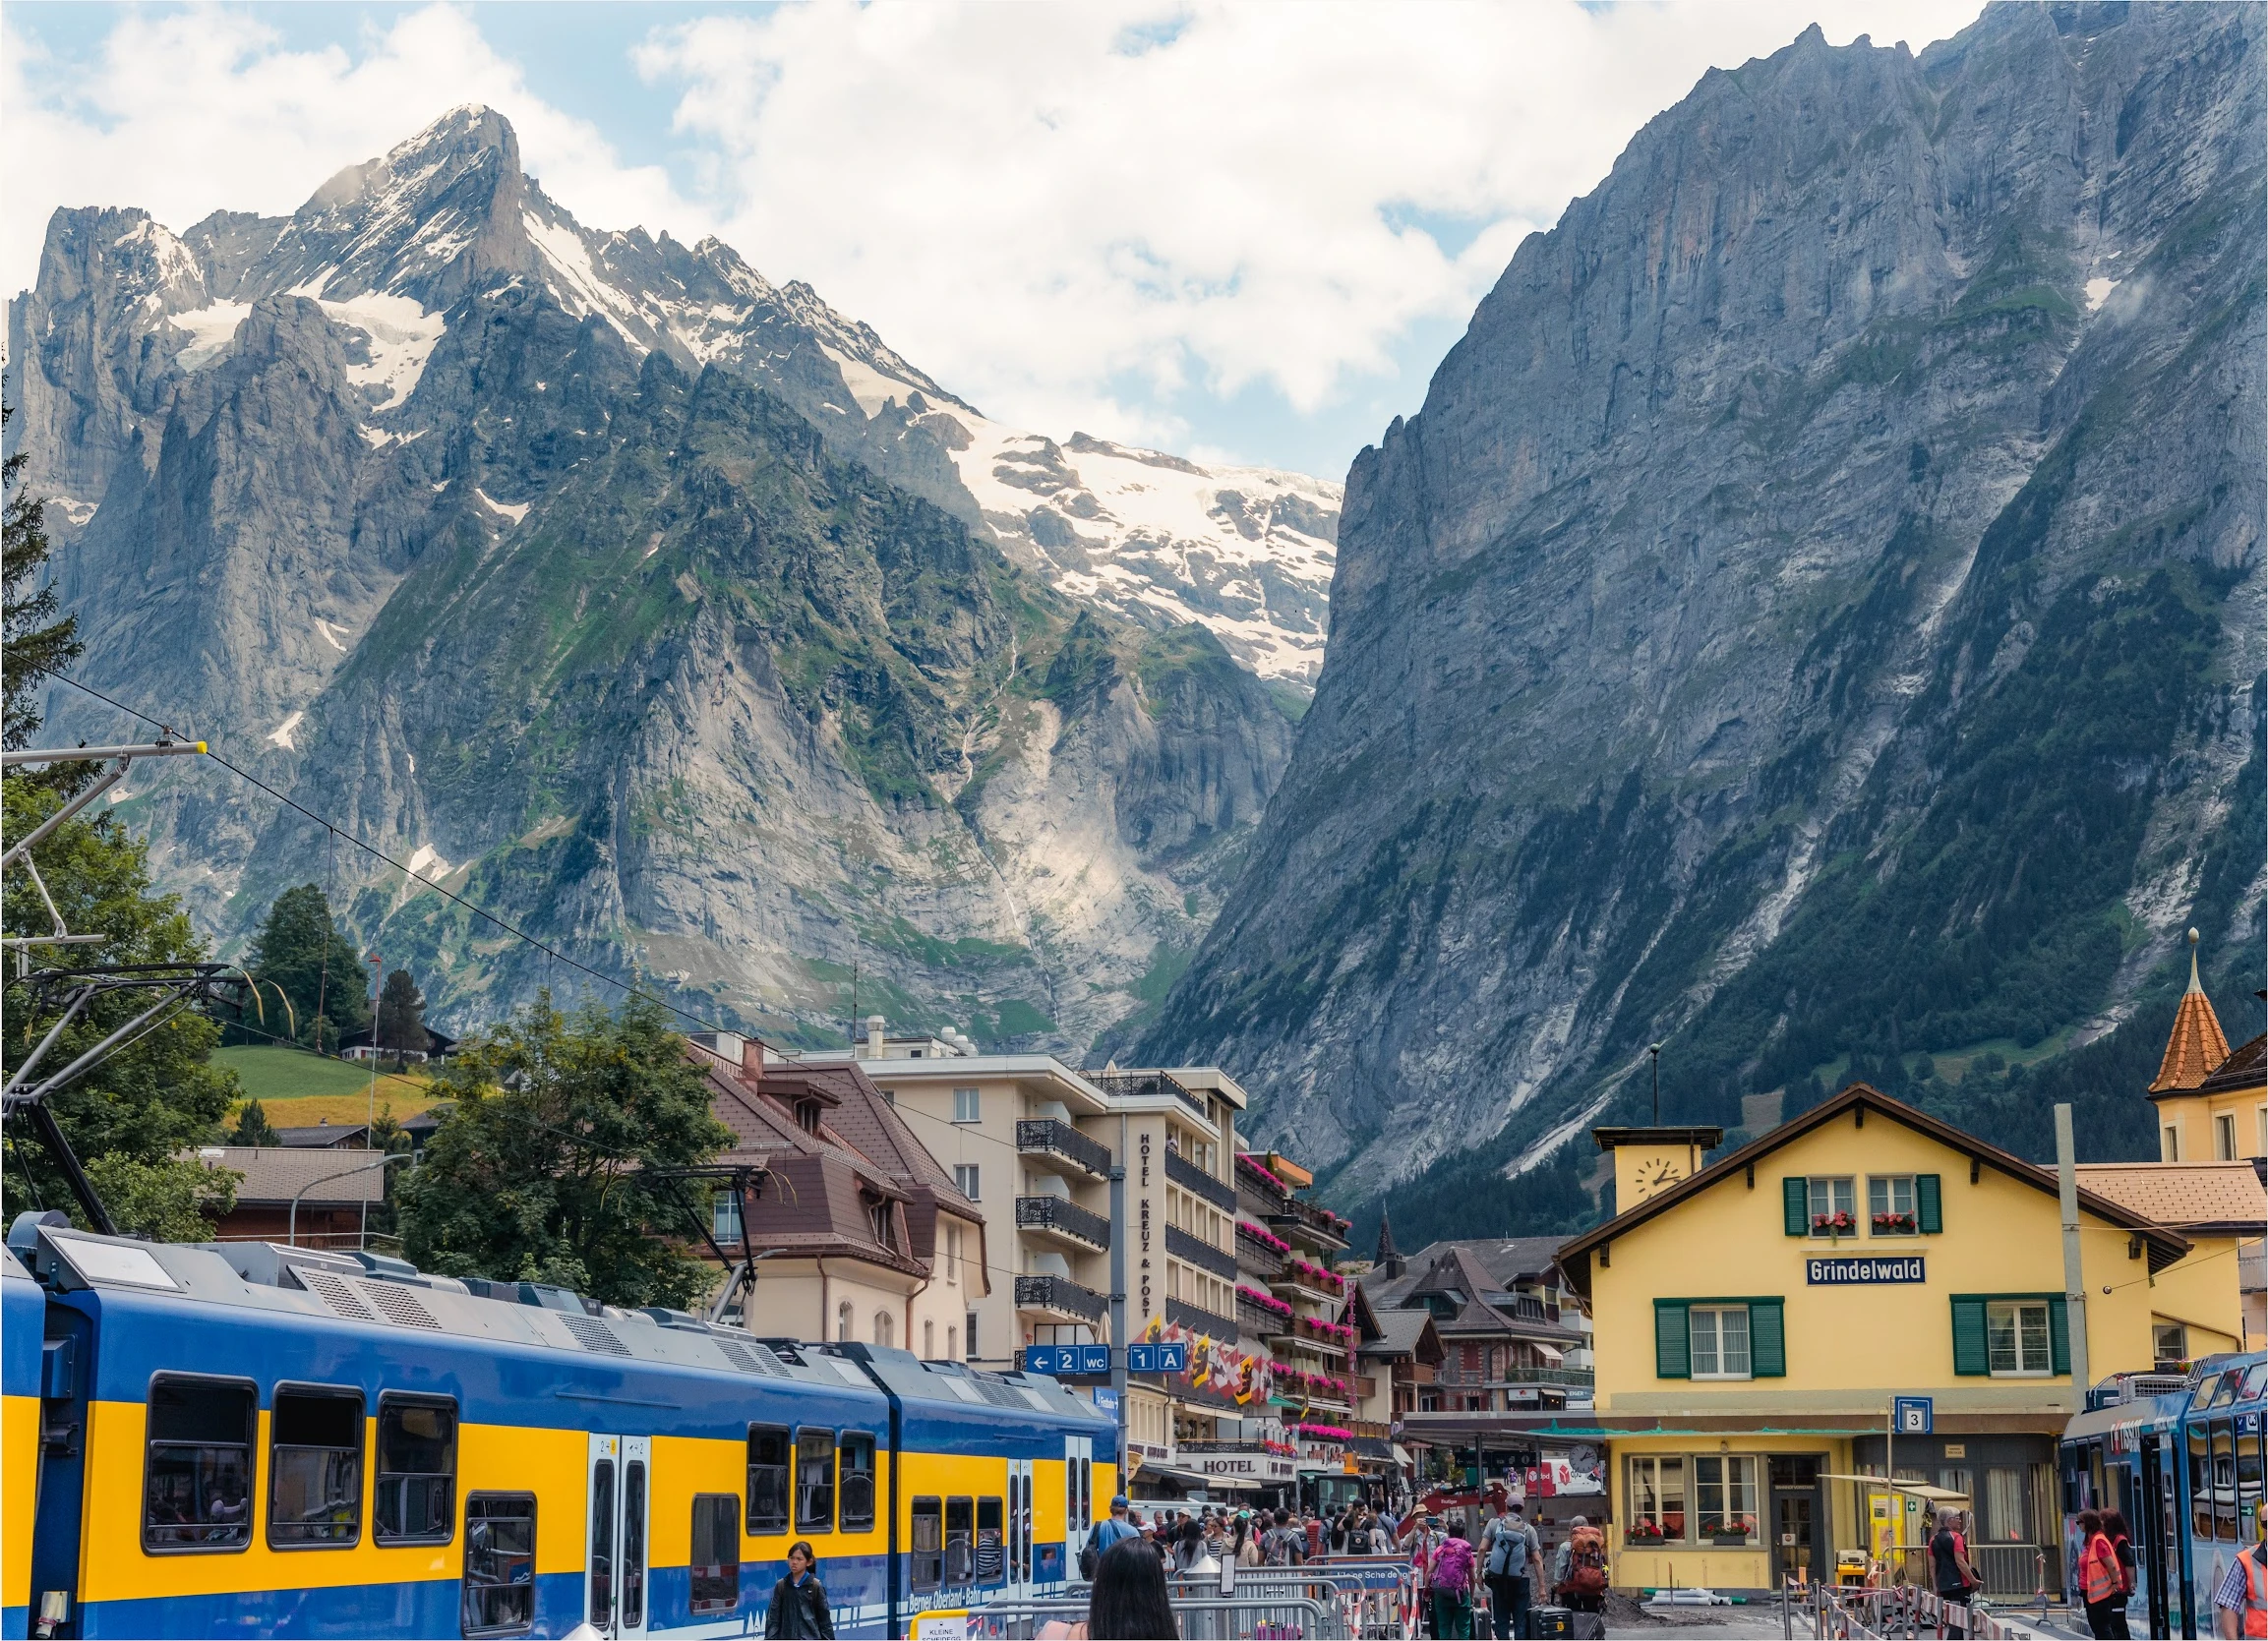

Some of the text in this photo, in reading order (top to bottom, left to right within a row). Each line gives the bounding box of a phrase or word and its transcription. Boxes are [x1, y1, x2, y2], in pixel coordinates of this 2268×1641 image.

[1141, 1134, 1151, 1318] HOTEL KREUZ & POST
[1811, 1260, 1921, 1281] Grindelwald
[1061, 1354, 1104, 1369] 2 WC
[1138, 1352, 1177, 1367] 1 A
[1910, 1414, 1919, 1426] 3
[1204, 1460, 1256, 1473] HOTEL
[909, 1594, 932, 1612] Berner
